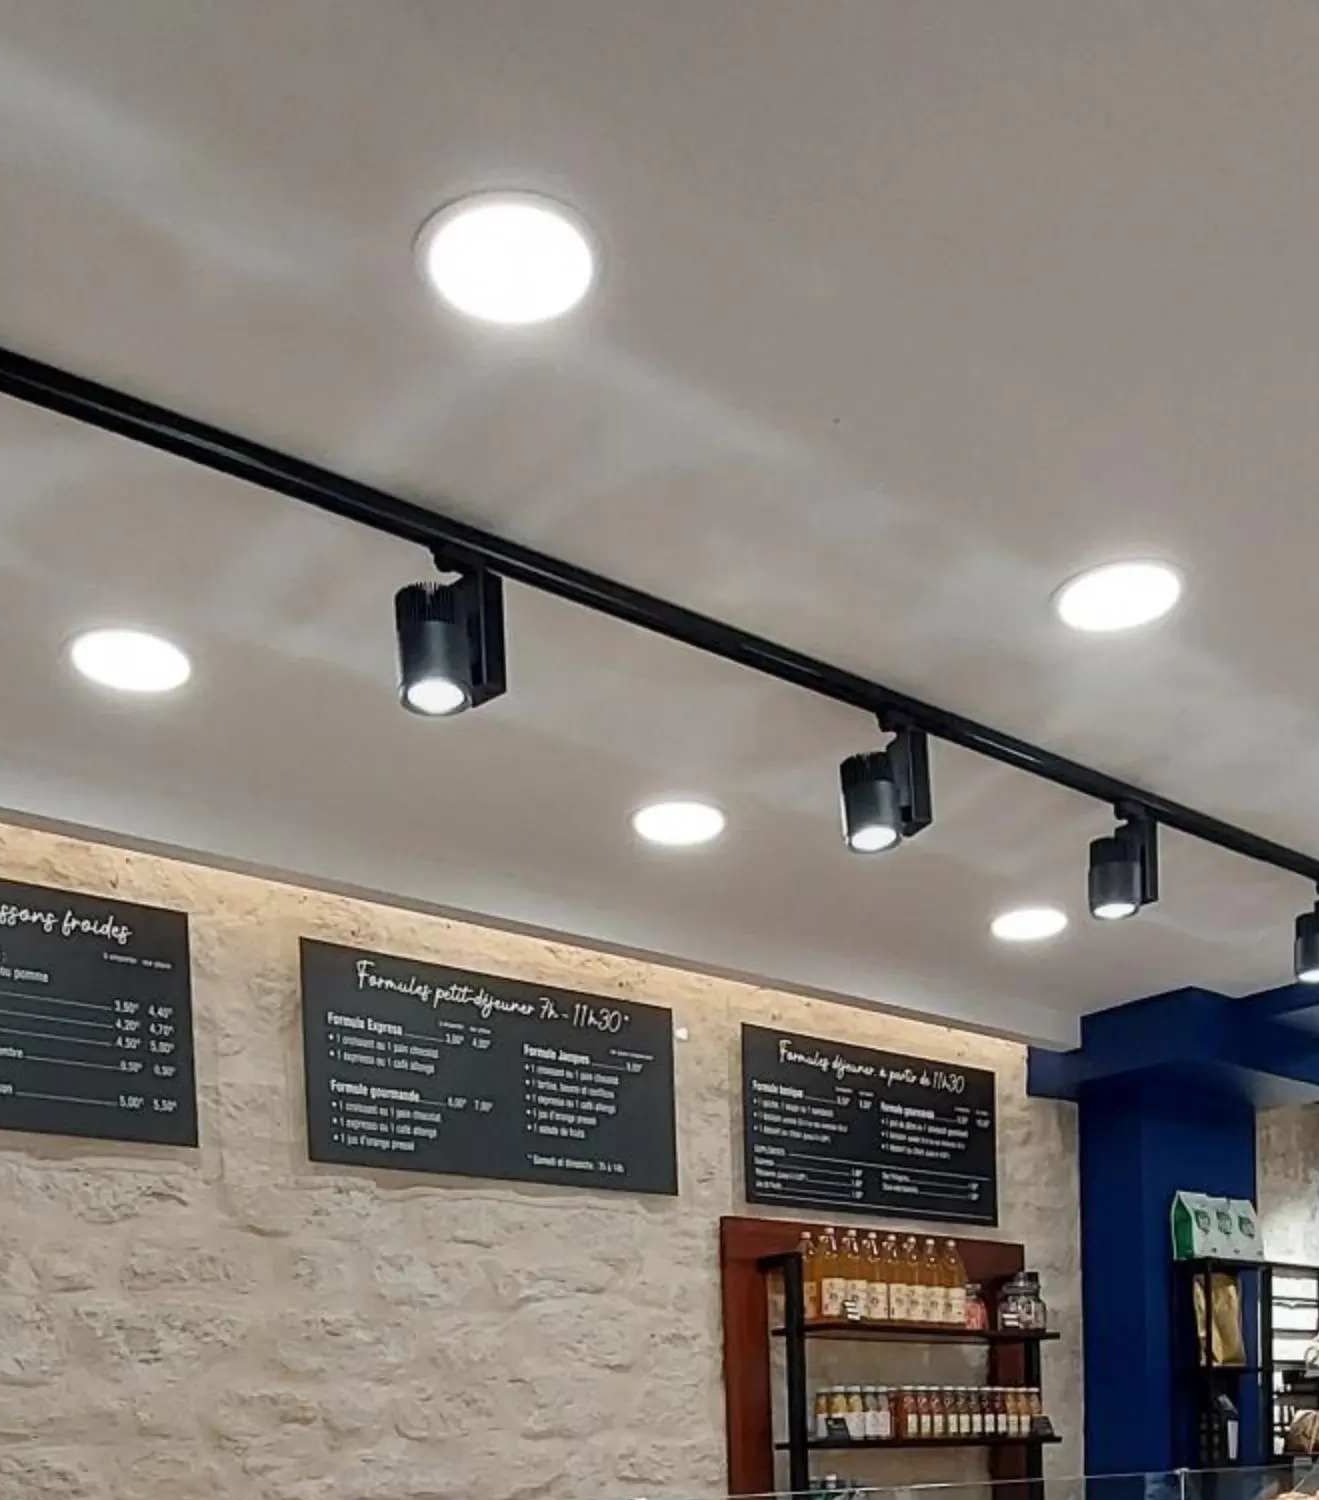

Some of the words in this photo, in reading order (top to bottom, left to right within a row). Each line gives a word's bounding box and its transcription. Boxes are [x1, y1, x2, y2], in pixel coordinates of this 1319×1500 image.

[63, 909, 132, 944] froides
[14, 967, 49, 983] pomme
[356, 959, 432, 1004] Formules
[539, 997, 559, 1020] 7h
[327, 1011, 365, 1030] Formule
[523, 1043, 557, 1060] Formule
[779, 1039, 829, 1072] Formules
[931, 1071, 965, 1094] 11h30
[330, 1079, 368, 1096] Formule
[370, 1086, 420, 1102] gourmande
